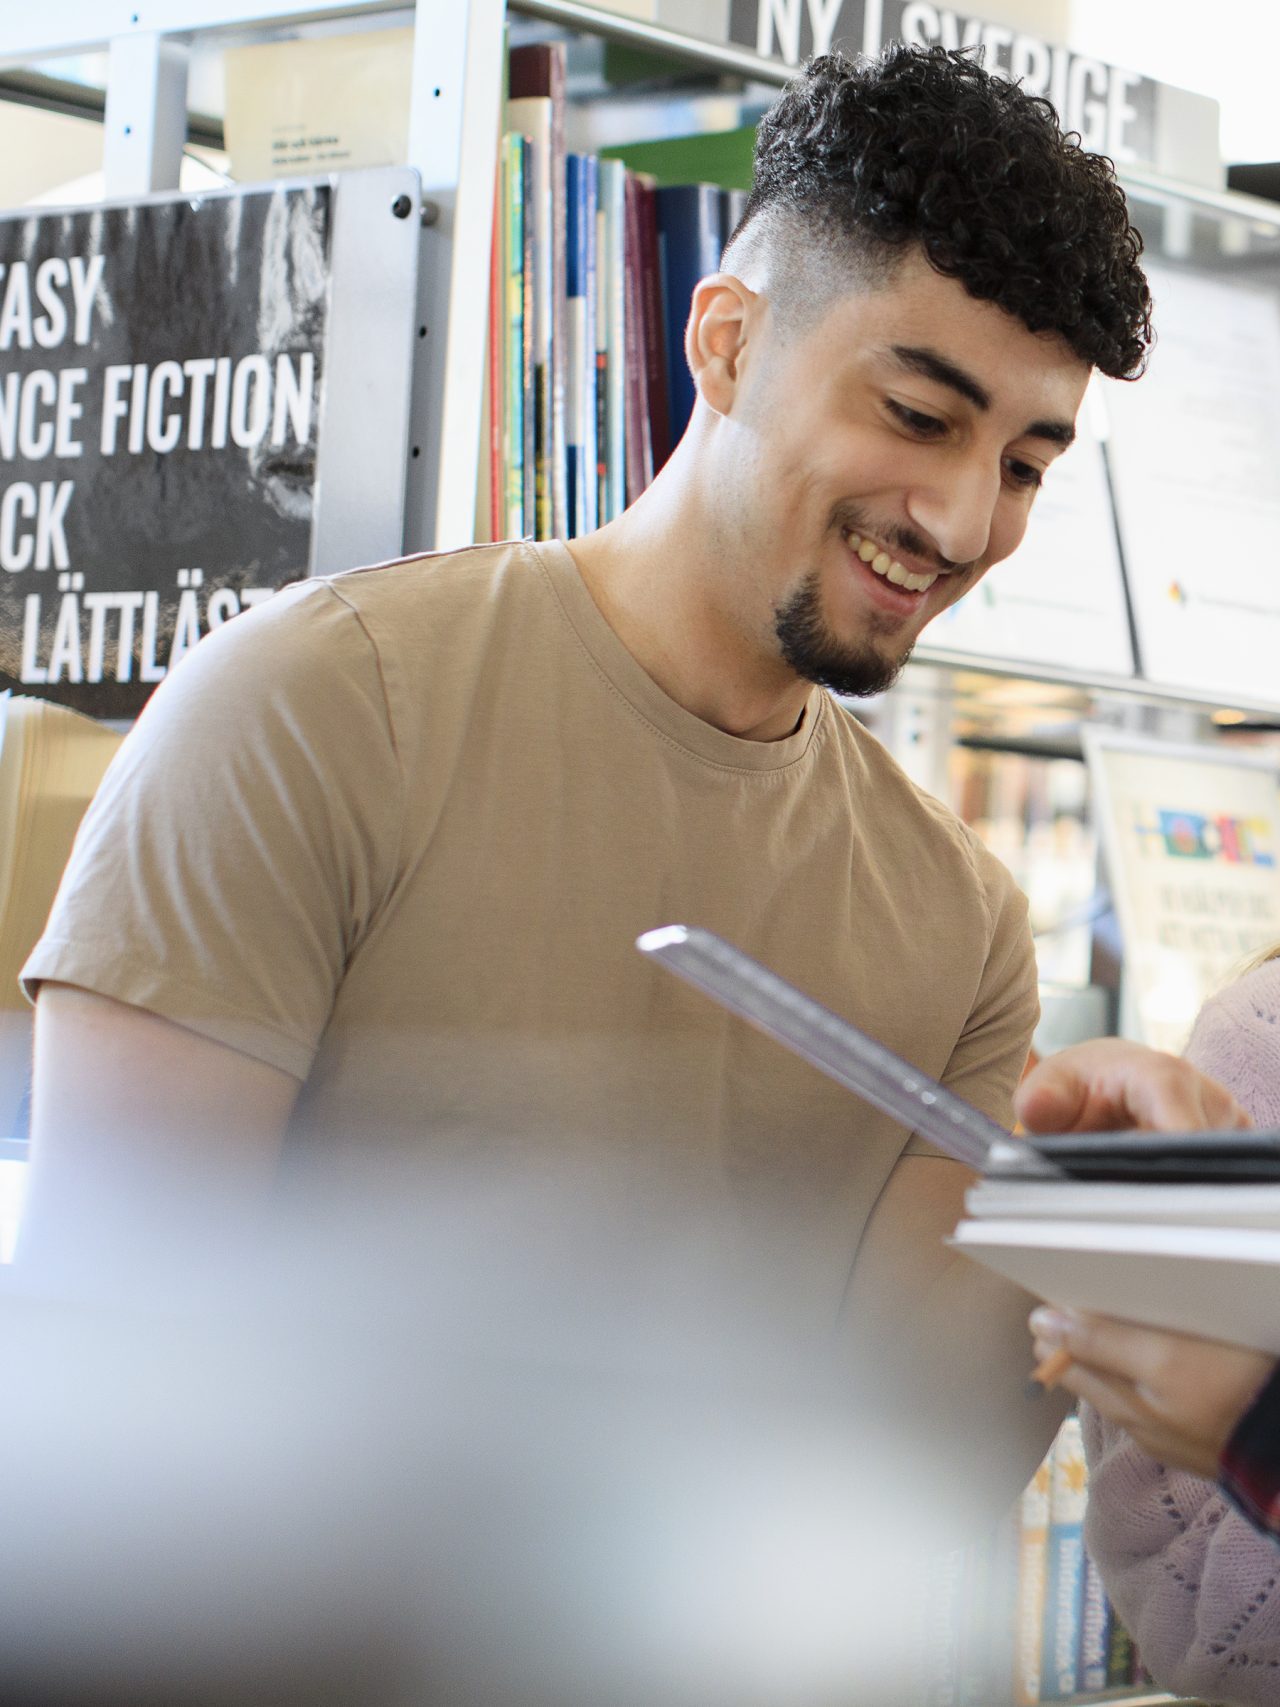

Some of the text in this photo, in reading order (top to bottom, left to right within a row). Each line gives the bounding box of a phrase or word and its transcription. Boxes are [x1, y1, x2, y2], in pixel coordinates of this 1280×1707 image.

[757, 0, 843, 66] NY
[0, 254, 105, 350] ASY
[101, 352, 314, 456] FICTION
[0, 480, 74, 573] CK
[20, 568, 275, 685] LÄTTLÄ
